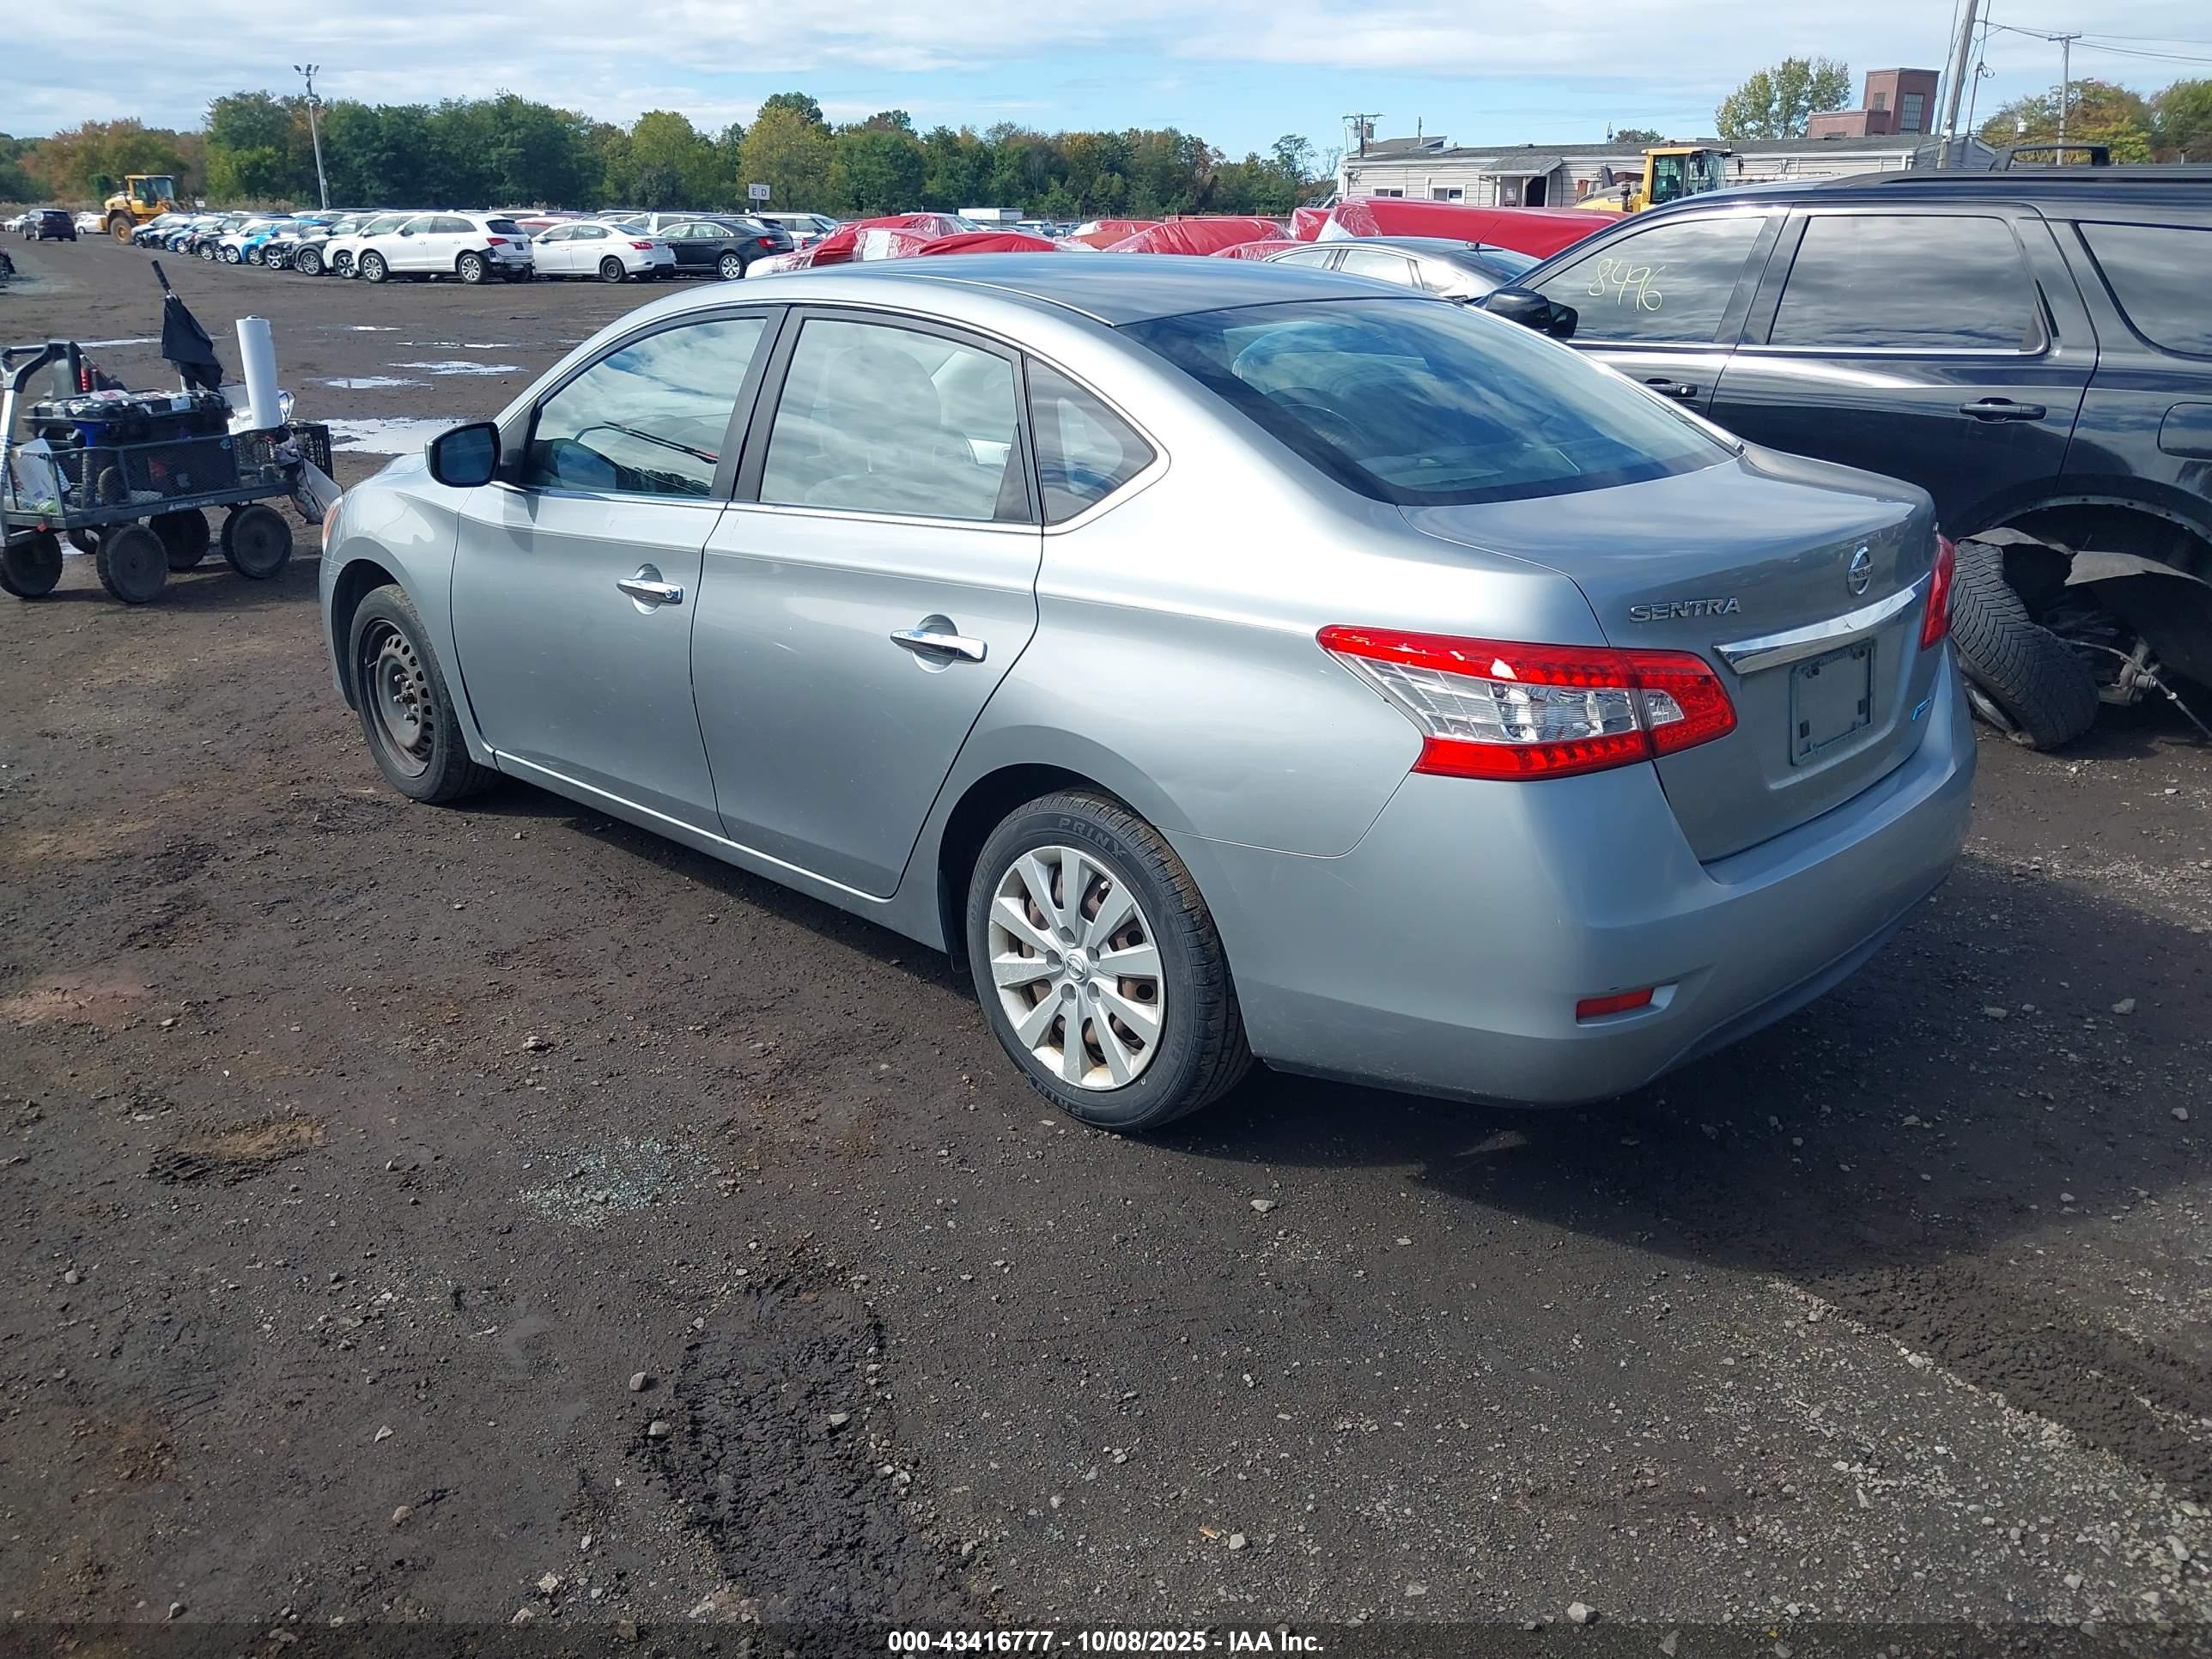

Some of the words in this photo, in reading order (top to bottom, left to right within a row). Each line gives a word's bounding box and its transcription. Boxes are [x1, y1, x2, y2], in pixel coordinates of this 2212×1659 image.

[751, 187, 757, 196] E
[761, 188, 767, 197] D
[1587, 258, 1667, 313] 8496
[1629, 597, 1741, 623] SENTRA
[1057, 817, 1127, 859] PRINX
